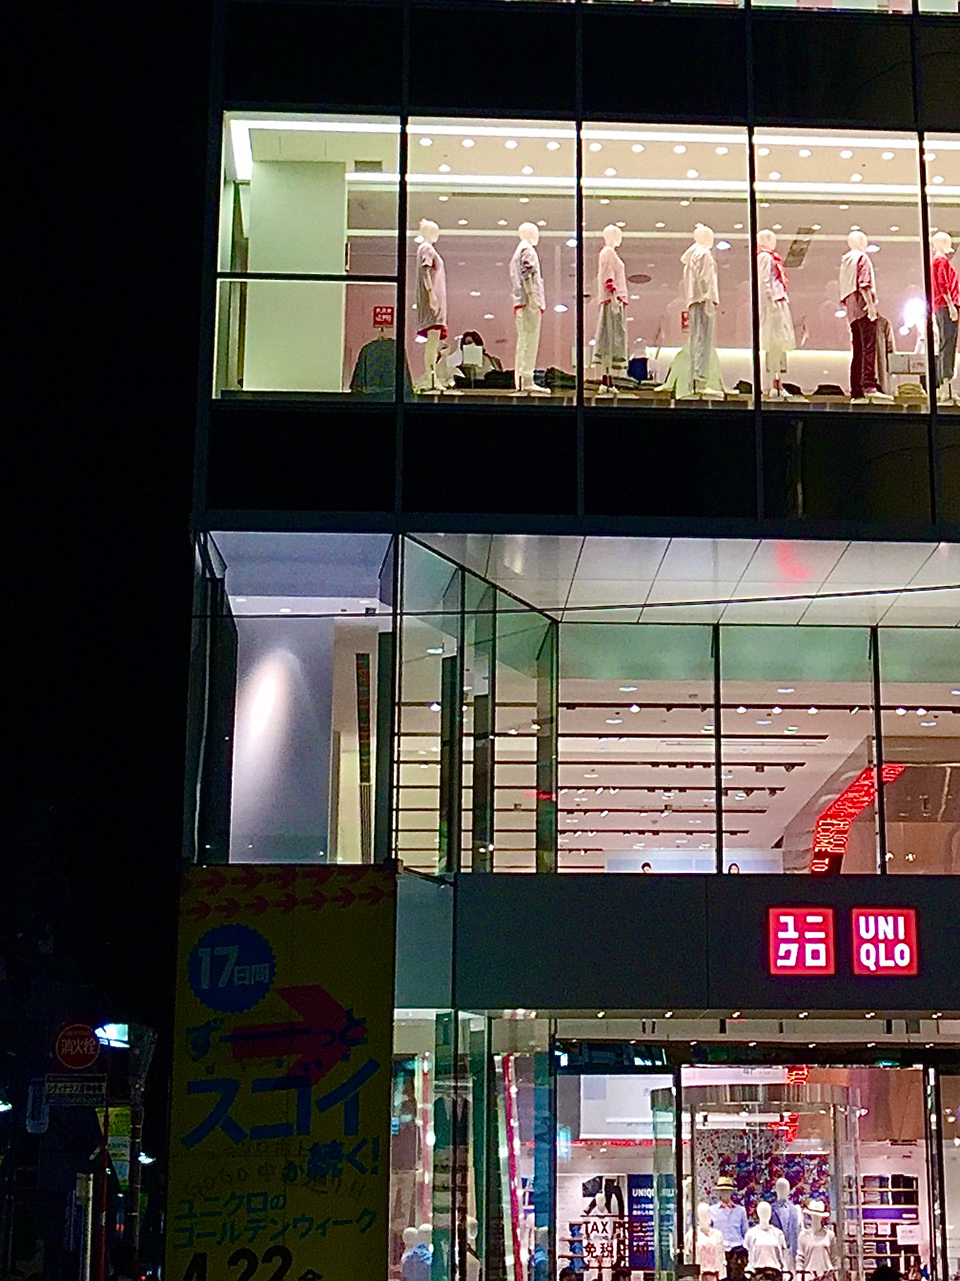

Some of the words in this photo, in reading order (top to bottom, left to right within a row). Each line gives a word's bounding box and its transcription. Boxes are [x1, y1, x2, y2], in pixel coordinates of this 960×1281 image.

[197, 944, 270, 990] 17日間
[174, 1191, 287, 1221] ユニクロの
